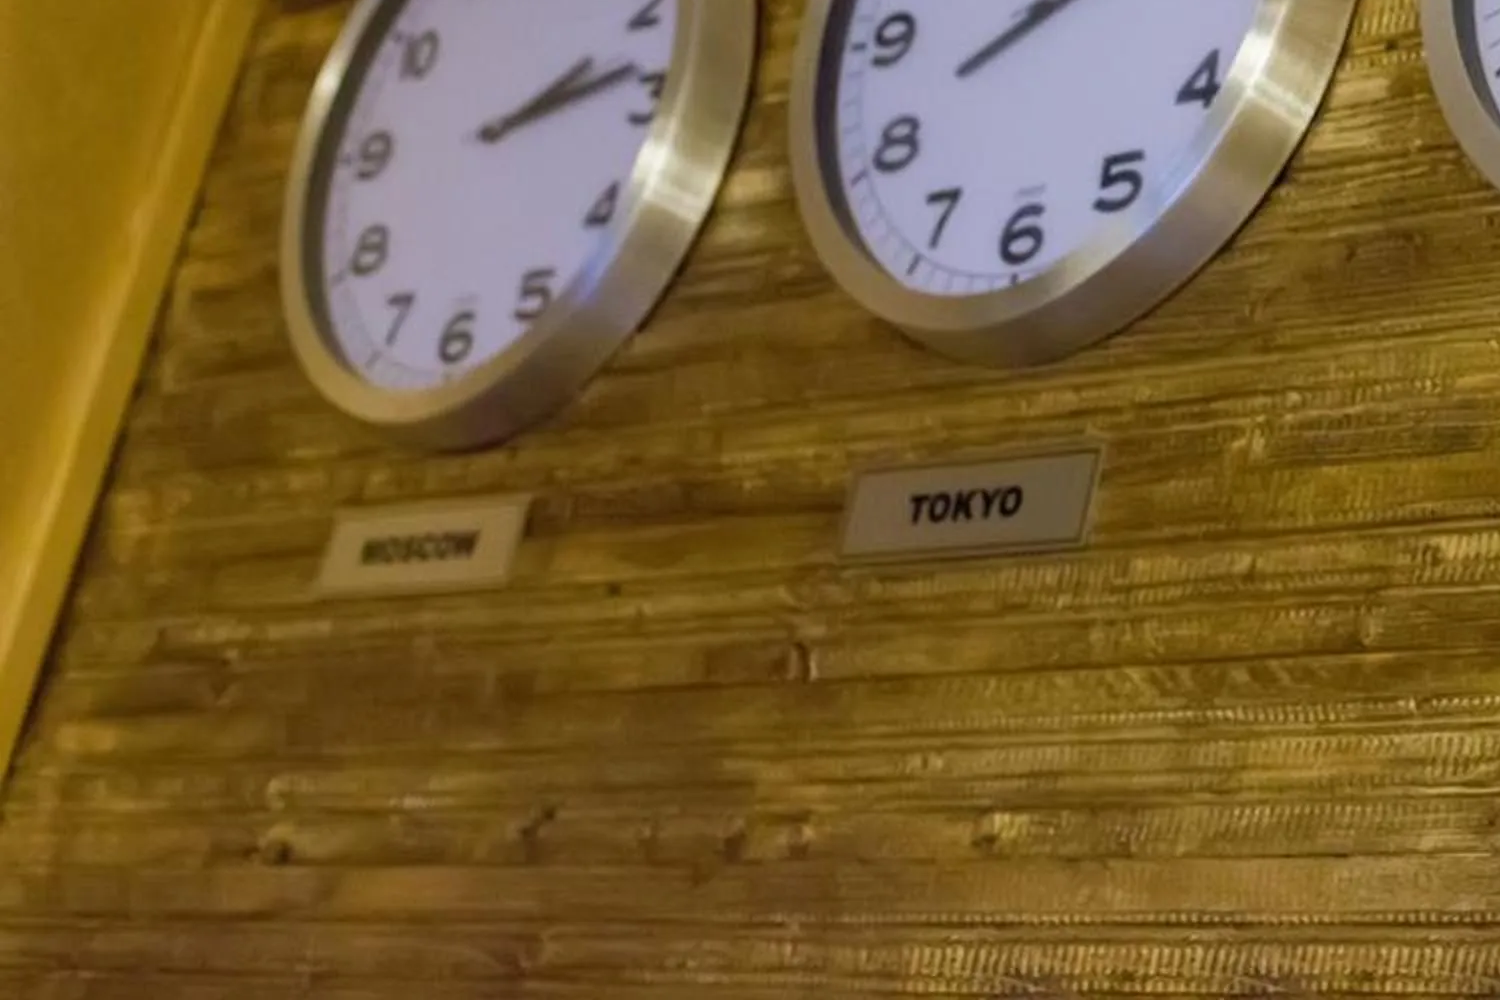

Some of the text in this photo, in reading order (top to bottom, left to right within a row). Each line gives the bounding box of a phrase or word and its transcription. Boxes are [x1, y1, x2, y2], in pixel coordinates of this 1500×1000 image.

[401, 30, 439, 80] 10
[870, 12, 917, 66] 9
[1175, 49, 1221, 109] 4
[356, 132, 393, 181] 9
[872, 116, 921, 172] 8
[1093, 150, 1146, 213] 5
[925, 188, 963, 250] 7
[998, 204, 1045, 265] 6
[350, 225, 389, 276] 8
[384, 292, 414, 345] 7
[514, 268, 557, 321] 5
[437, 312, 476, 364] 6
[909, 486, 1024, 524] TOKYO
[360, 528, 481, 565] MOSCOW
